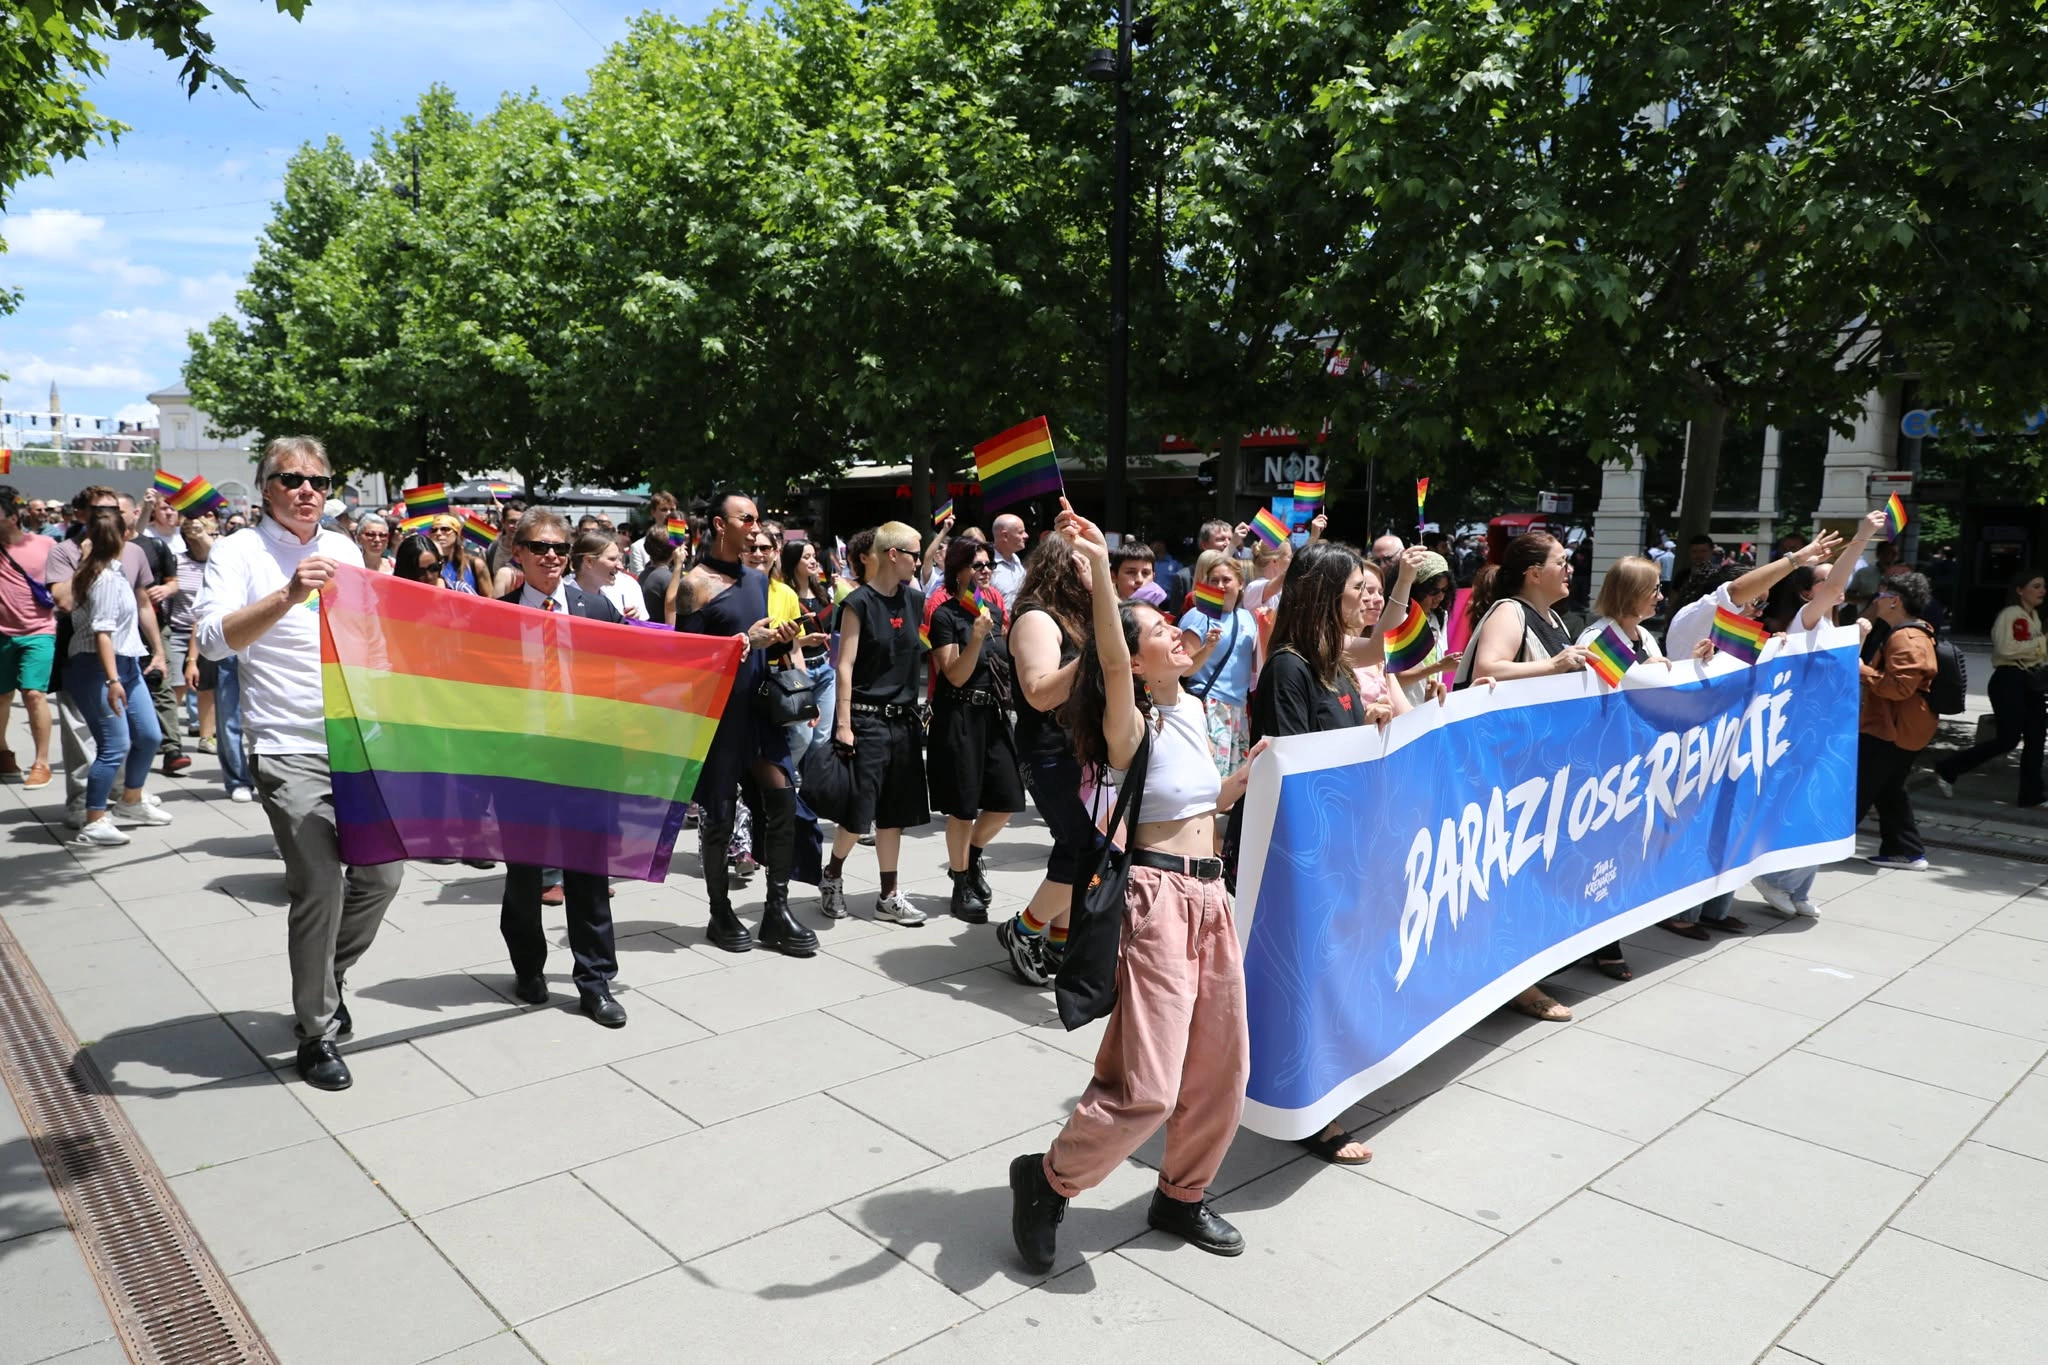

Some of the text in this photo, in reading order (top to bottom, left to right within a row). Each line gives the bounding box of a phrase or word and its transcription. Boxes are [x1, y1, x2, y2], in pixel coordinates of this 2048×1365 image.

[1395, 670, 1793, 993] BARAZI OSE REVOLTË
